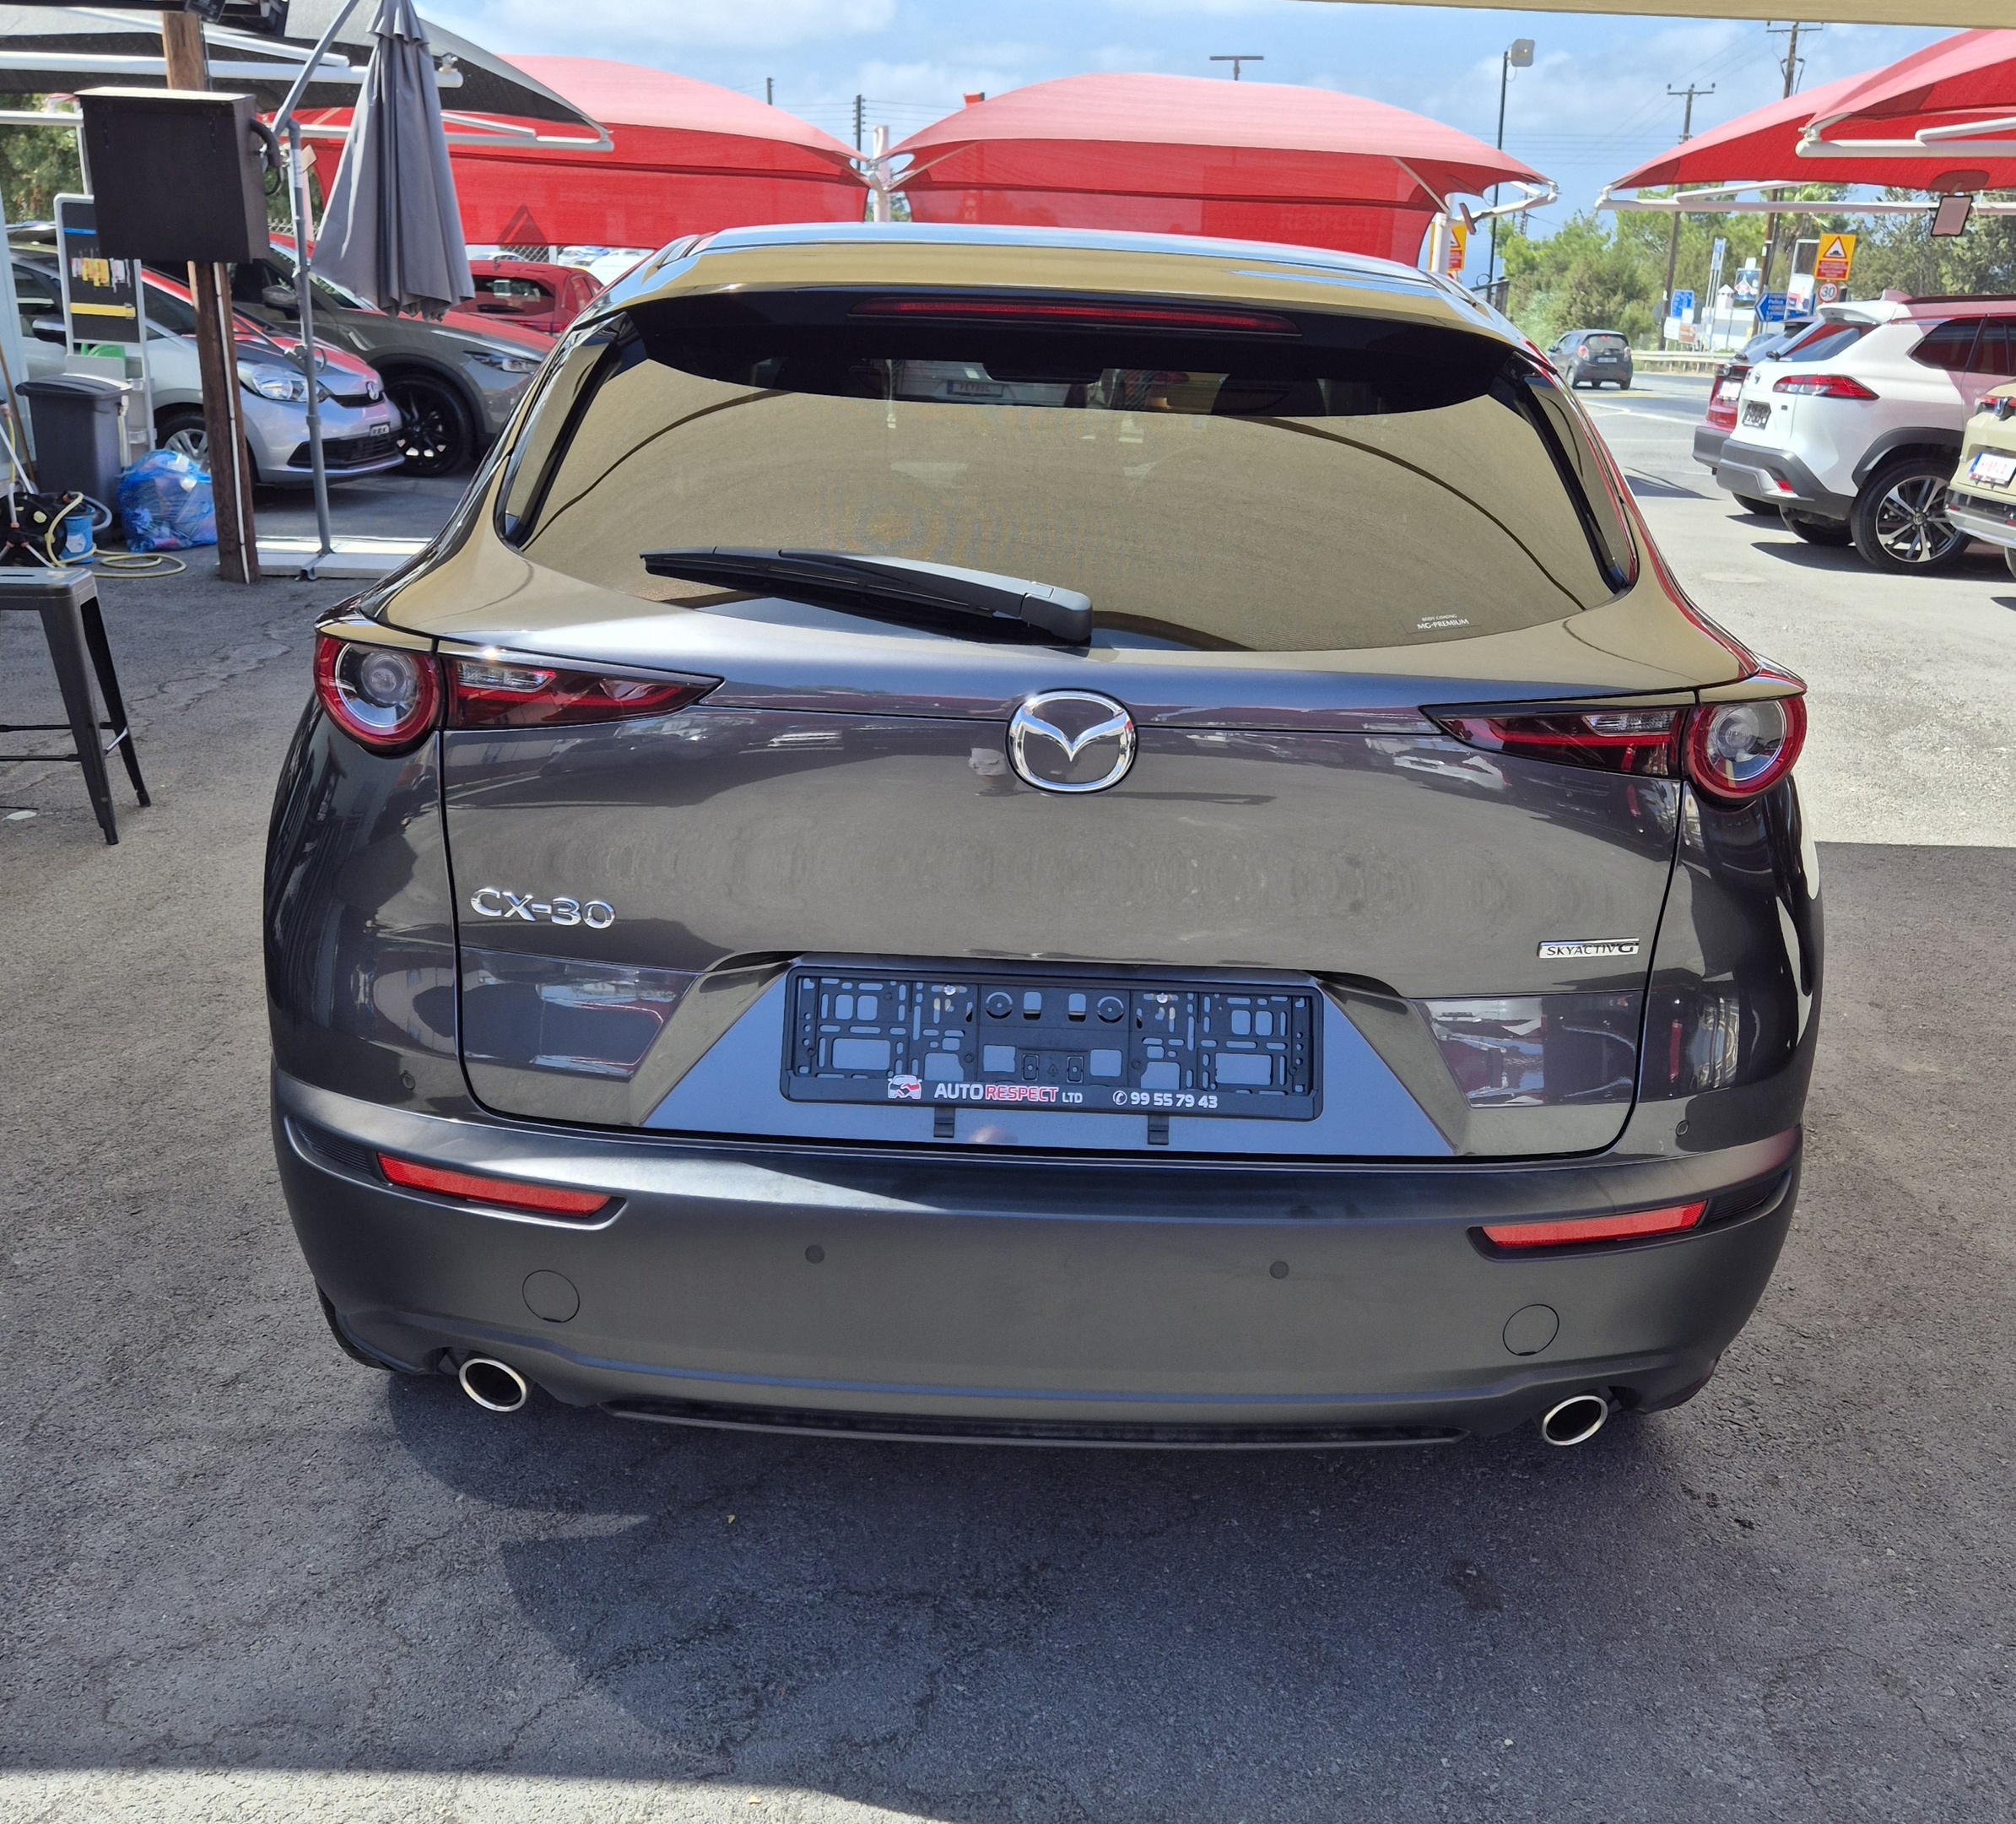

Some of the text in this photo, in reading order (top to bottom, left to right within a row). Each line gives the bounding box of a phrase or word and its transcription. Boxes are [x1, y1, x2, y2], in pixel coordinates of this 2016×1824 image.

[1821, 286, 1835, 298] 30
[471, 887, 616, 929] CX-30
[1062, 1092, 1084, 1104] LTD
[1130, 1091, 1150, 1106] 99
[1154, 1092, 1173, 1107] 55
[1176, 1094, 1195, 1107] 79
[1198, 1095, 1219, 1109] 43
